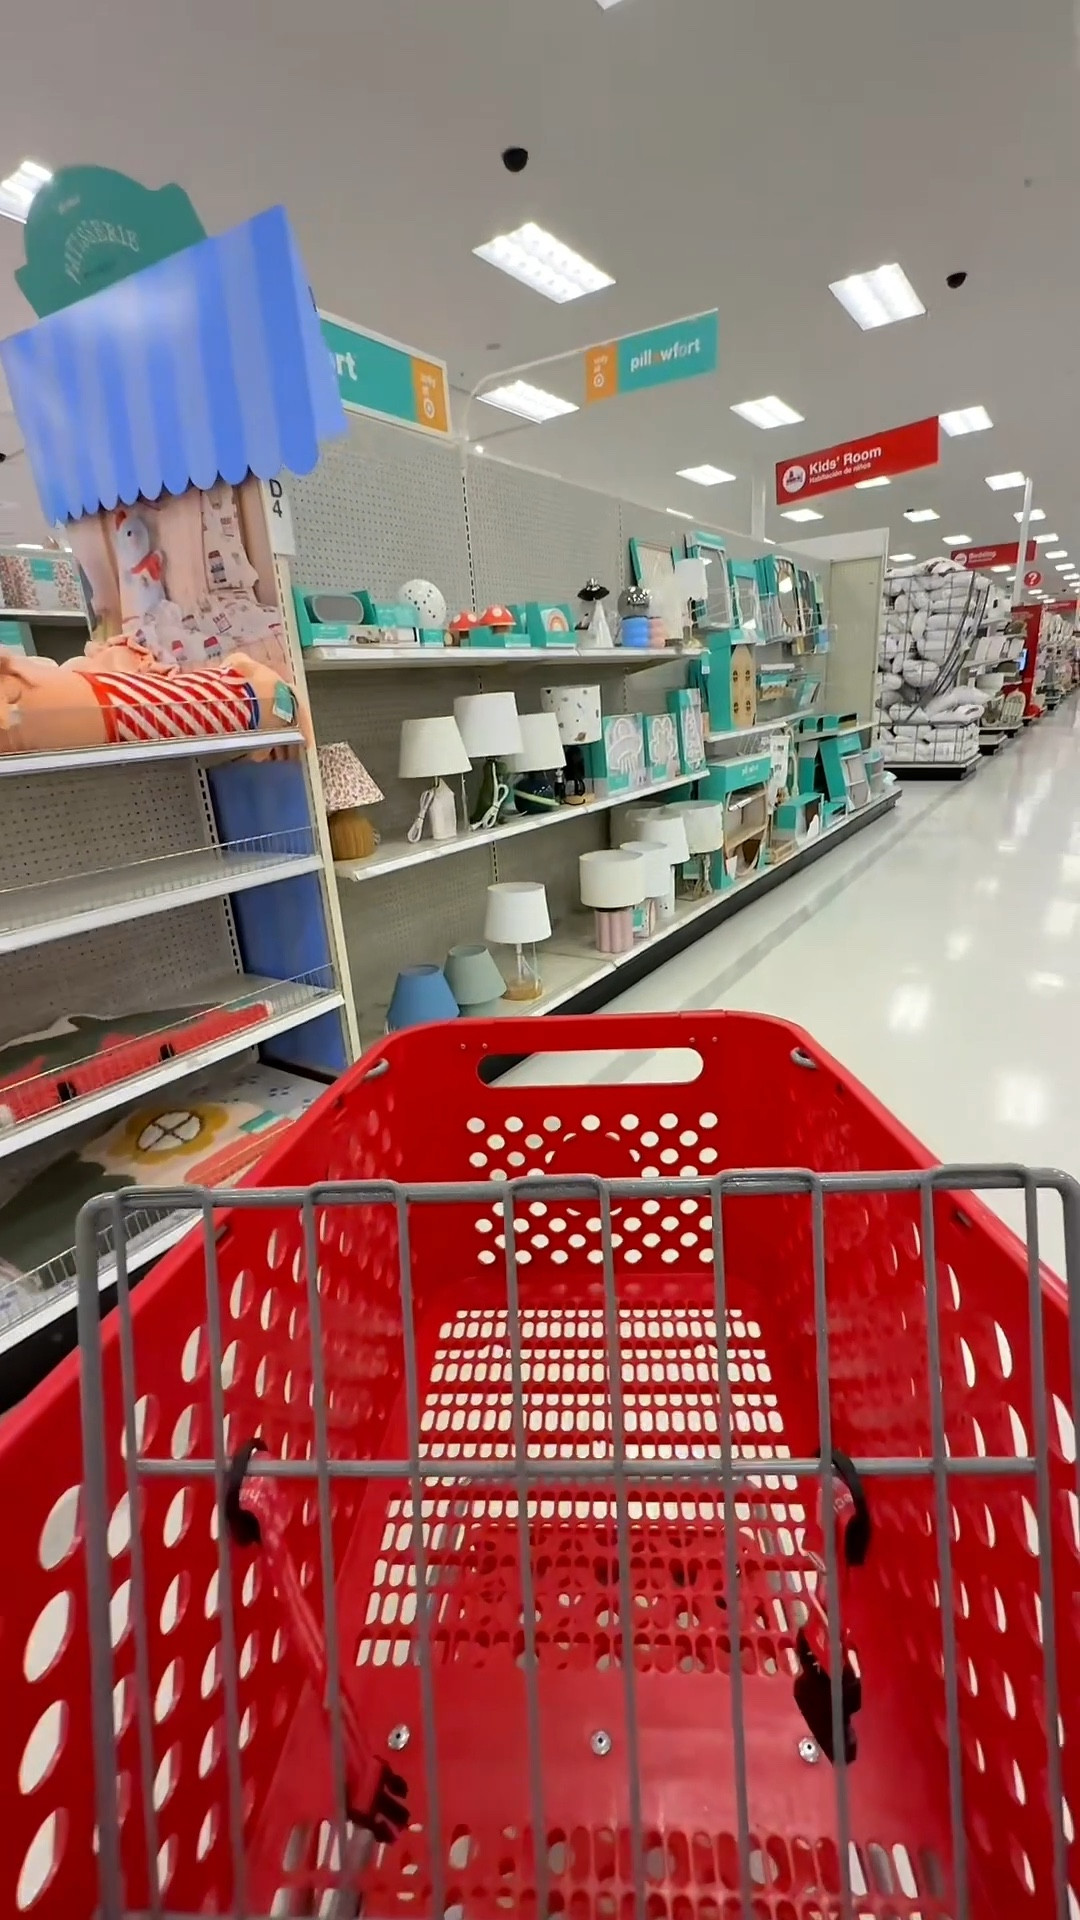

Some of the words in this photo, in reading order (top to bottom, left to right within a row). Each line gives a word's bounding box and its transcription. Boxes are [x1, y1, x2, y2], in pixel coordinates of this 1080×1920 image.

[64, 219, 139, 285] PATISSERIE
[630, 338, 700, 373] pillowfort
[809, 456, 841, 476] Kids'
[843, 446, 882, 466] Room
[269, 478, 282, 498] D
[272, 499, 283, 518] 4
